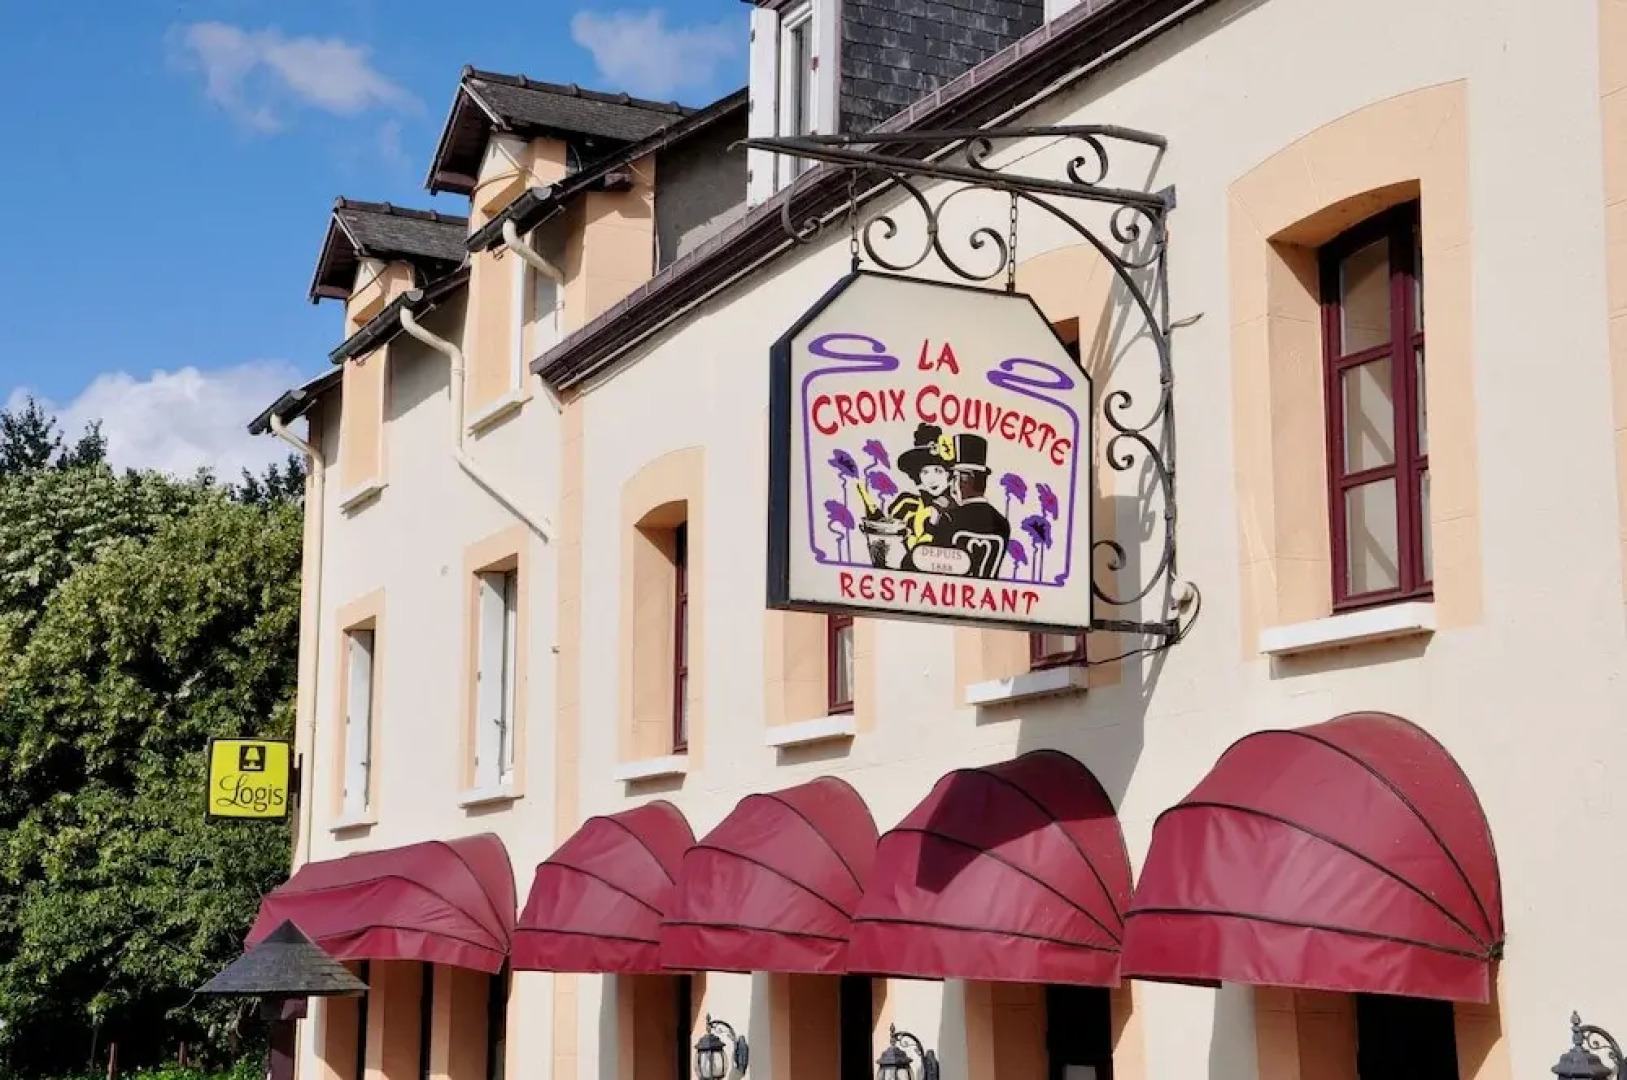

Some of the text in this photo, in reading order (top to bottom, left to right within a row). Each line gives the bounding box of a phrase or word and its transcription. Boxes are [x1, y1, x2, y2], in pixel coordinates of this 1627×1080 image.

[917, 338, 960, 375] LA
[811, 384, 1072, 466] CROIX COUVERTE
[922, 546, 962, 560] DEPUIS
[839, 571, 1039, 615] RESTAURANT
[216, 773, 284, 812] Logis
